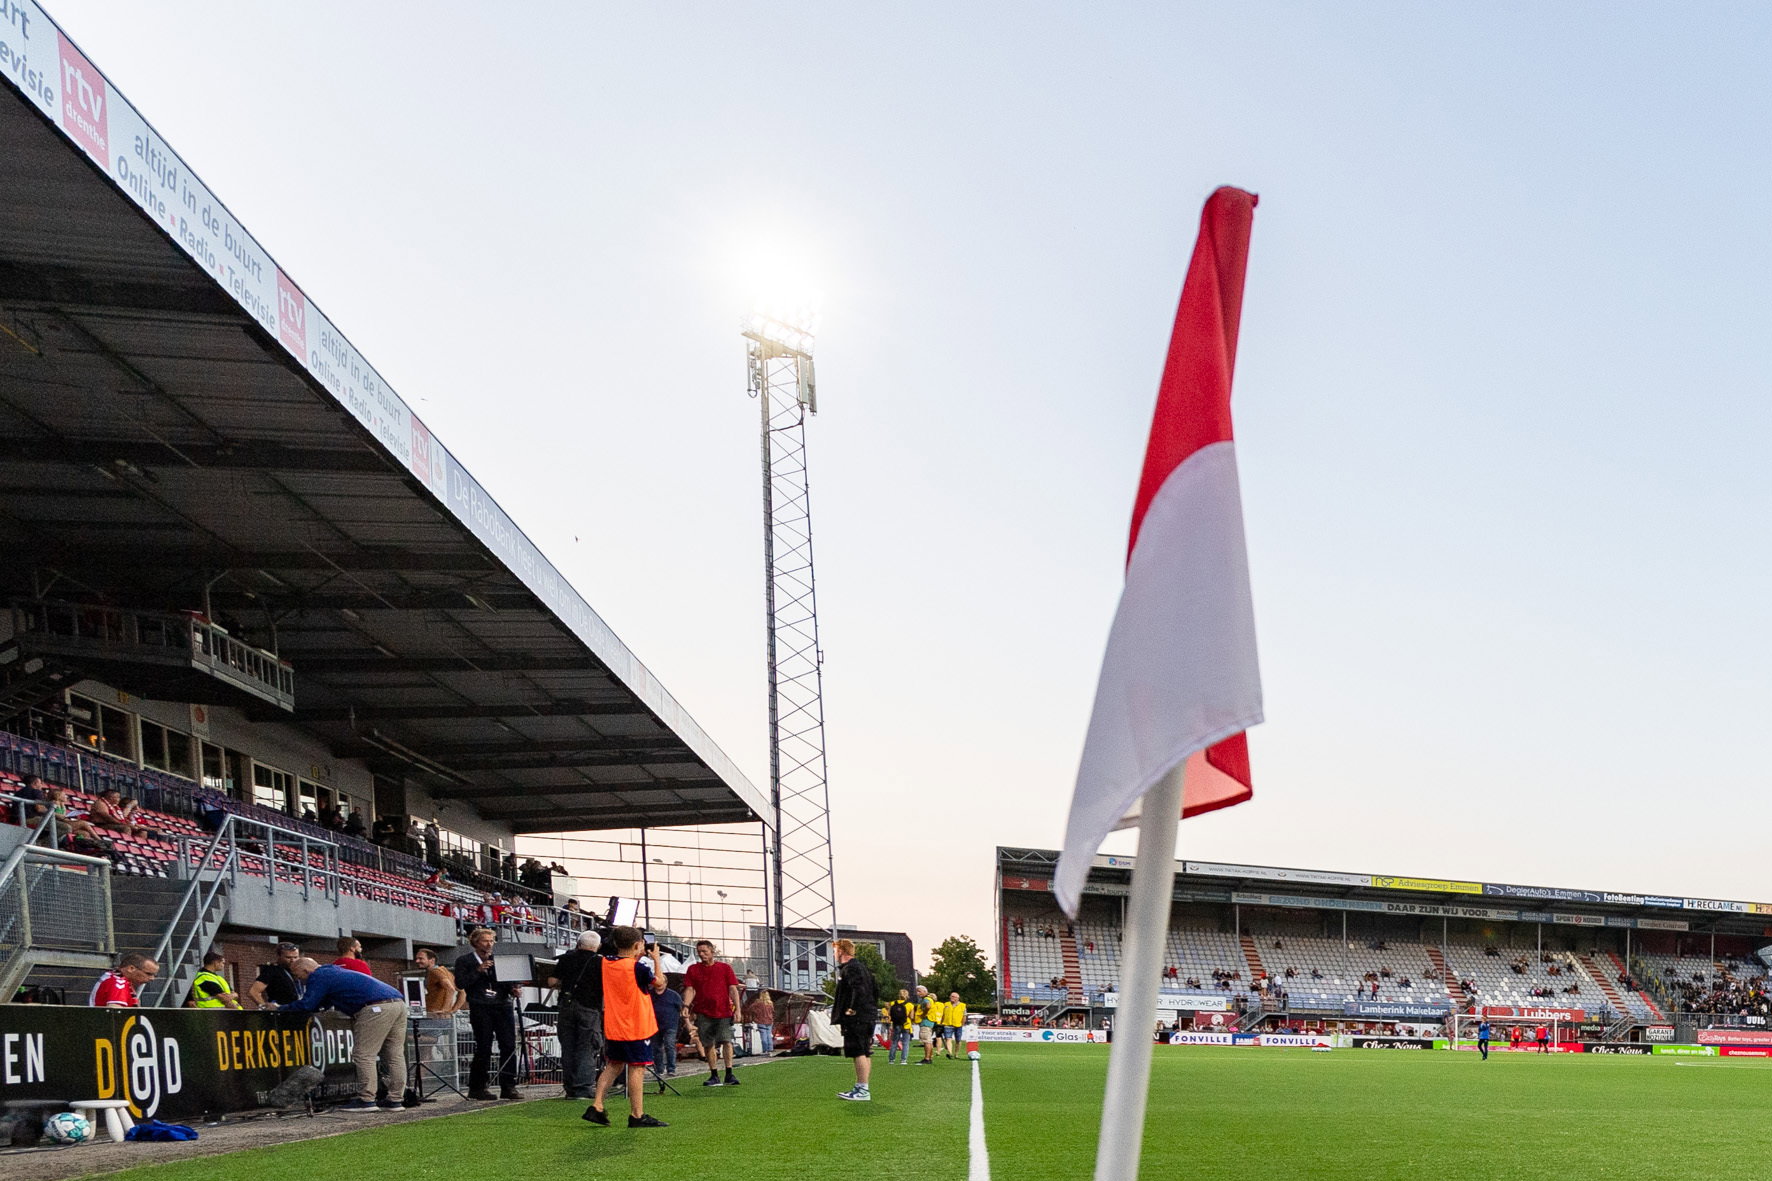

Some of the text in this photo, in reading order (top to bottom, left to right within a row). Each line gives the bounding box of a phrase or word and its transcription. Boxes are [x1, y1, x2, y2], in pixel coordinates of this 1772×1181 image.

[62, 57, 102, 122] rtv
[66, 101, 106, 150] drenthe
[135, 135, 263, 283] altijd in de buurt
[118, 155, 275, 330] Online Radio Televisie
[279, 286, 303, 329] rtv
[321, 329, 401, 426] altijd in de buurt
[311, 350, 409, 462] Online Radio Televisie
[454, 468, 469, 510] De
[470, 486, 516, 559] Rabobank
[1398, 880, 1449, 890] Adviesgroep
[1450, 882, 1479, 892] Emmen
[1554, 890, 1582, 898] Emmen
[1387, 903, 1416, 913] DAAR
[1419, 904, 1440, 914] ZIJN
[1442, 906, 1459, 915] WIJ
[1462, 908, 1490, 918] VOOR.
[1359, 1005, 1404, 1016] Lamberink
[1524, 1009, 1571, 1020] Lubbers
[216, 1030, 305, 1071] DERKSEN
[1266, 1037, 1316, 1045] FONVILLE
